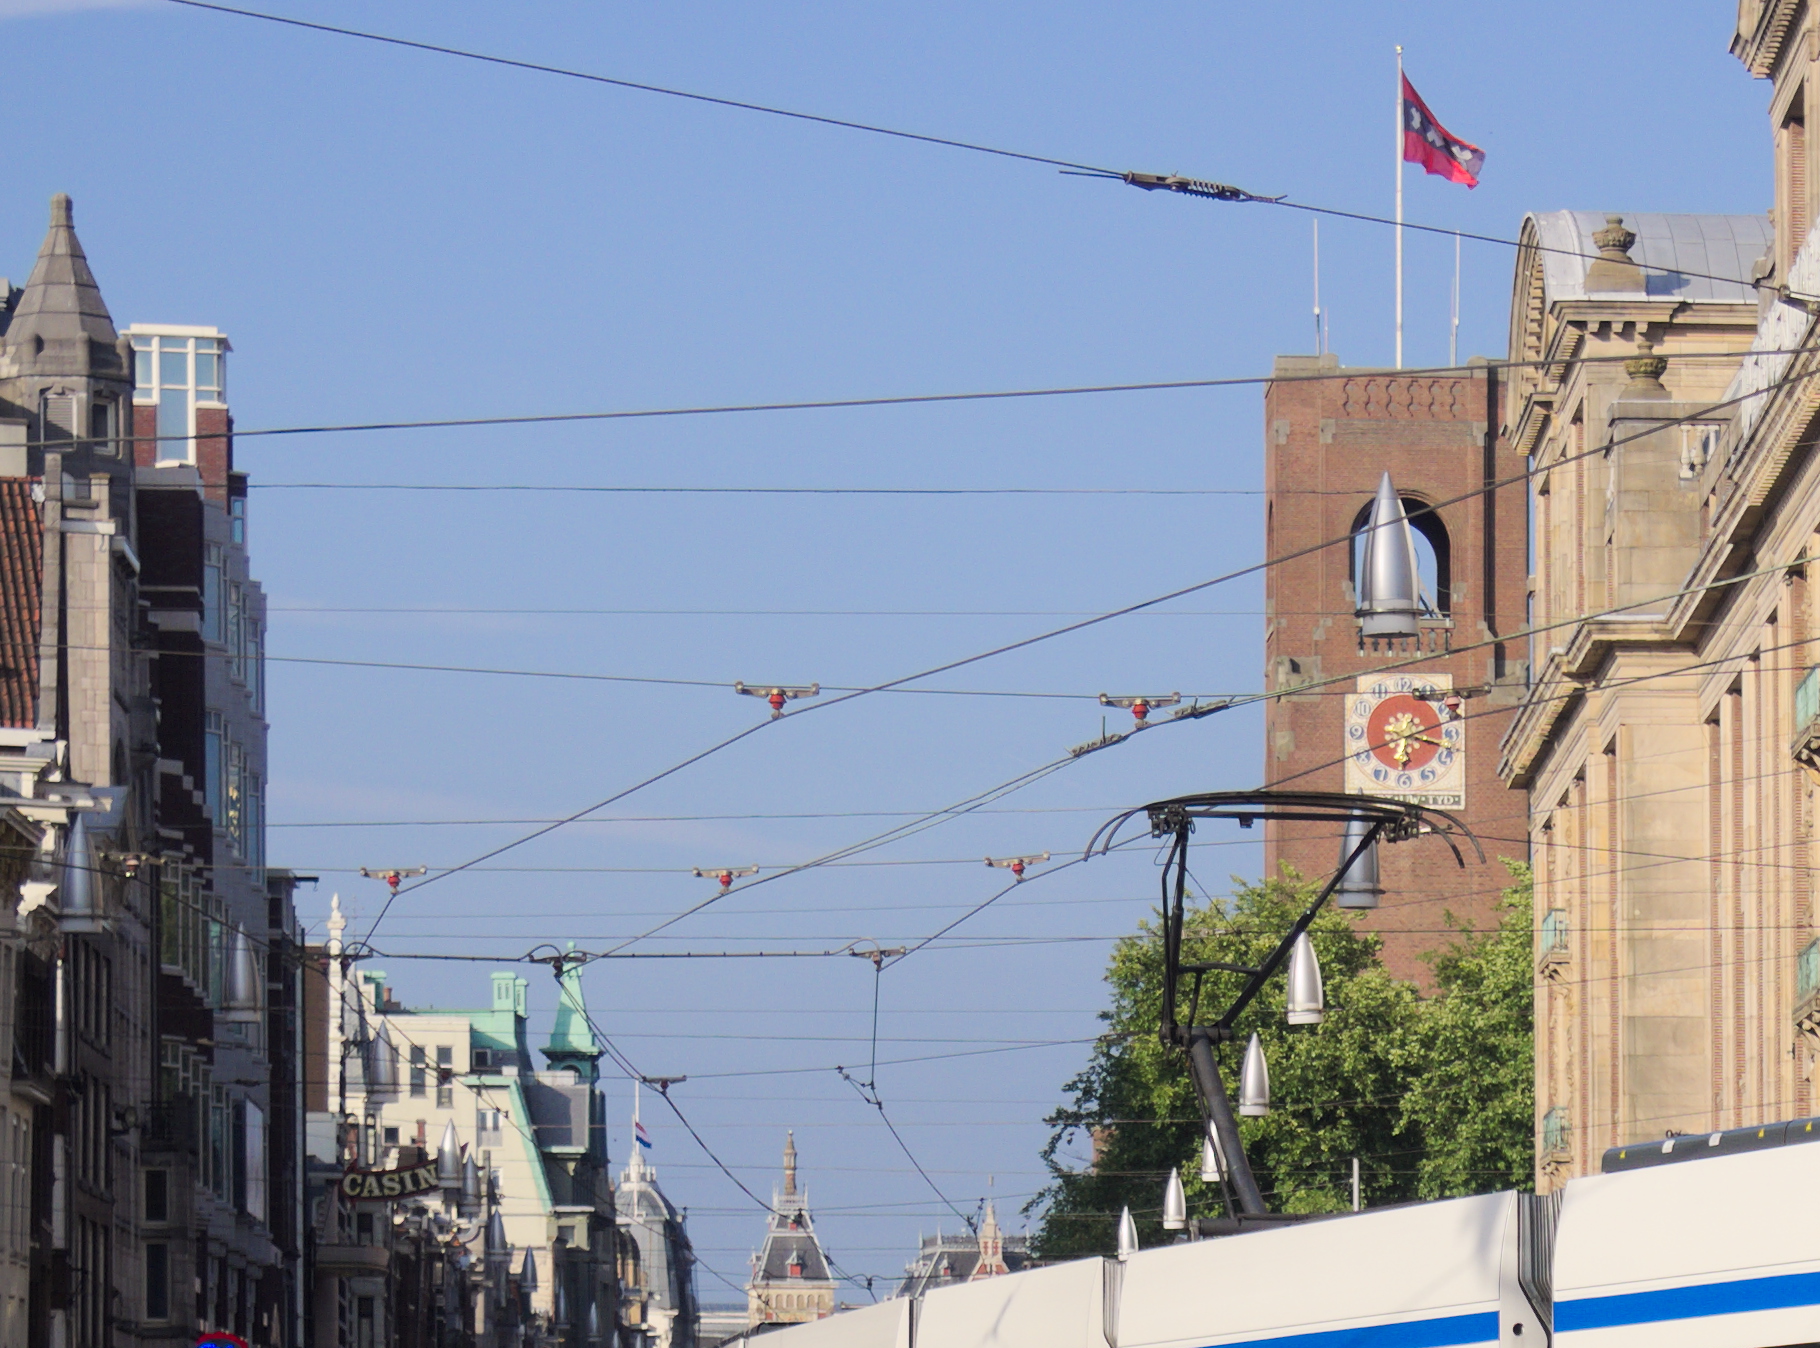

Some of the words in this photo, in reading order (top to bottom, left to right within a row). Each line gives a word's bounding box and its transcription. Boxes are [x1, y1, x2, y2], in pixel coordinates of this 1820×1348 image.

[1398, 678, 1412, 691] 12
[1357, 701, 1370, 716] 10
[1351, 725, 1363, 739] 9
[1400, 773, 1411, 788] 6
[343, 1163, 440, 1197] CASIN
